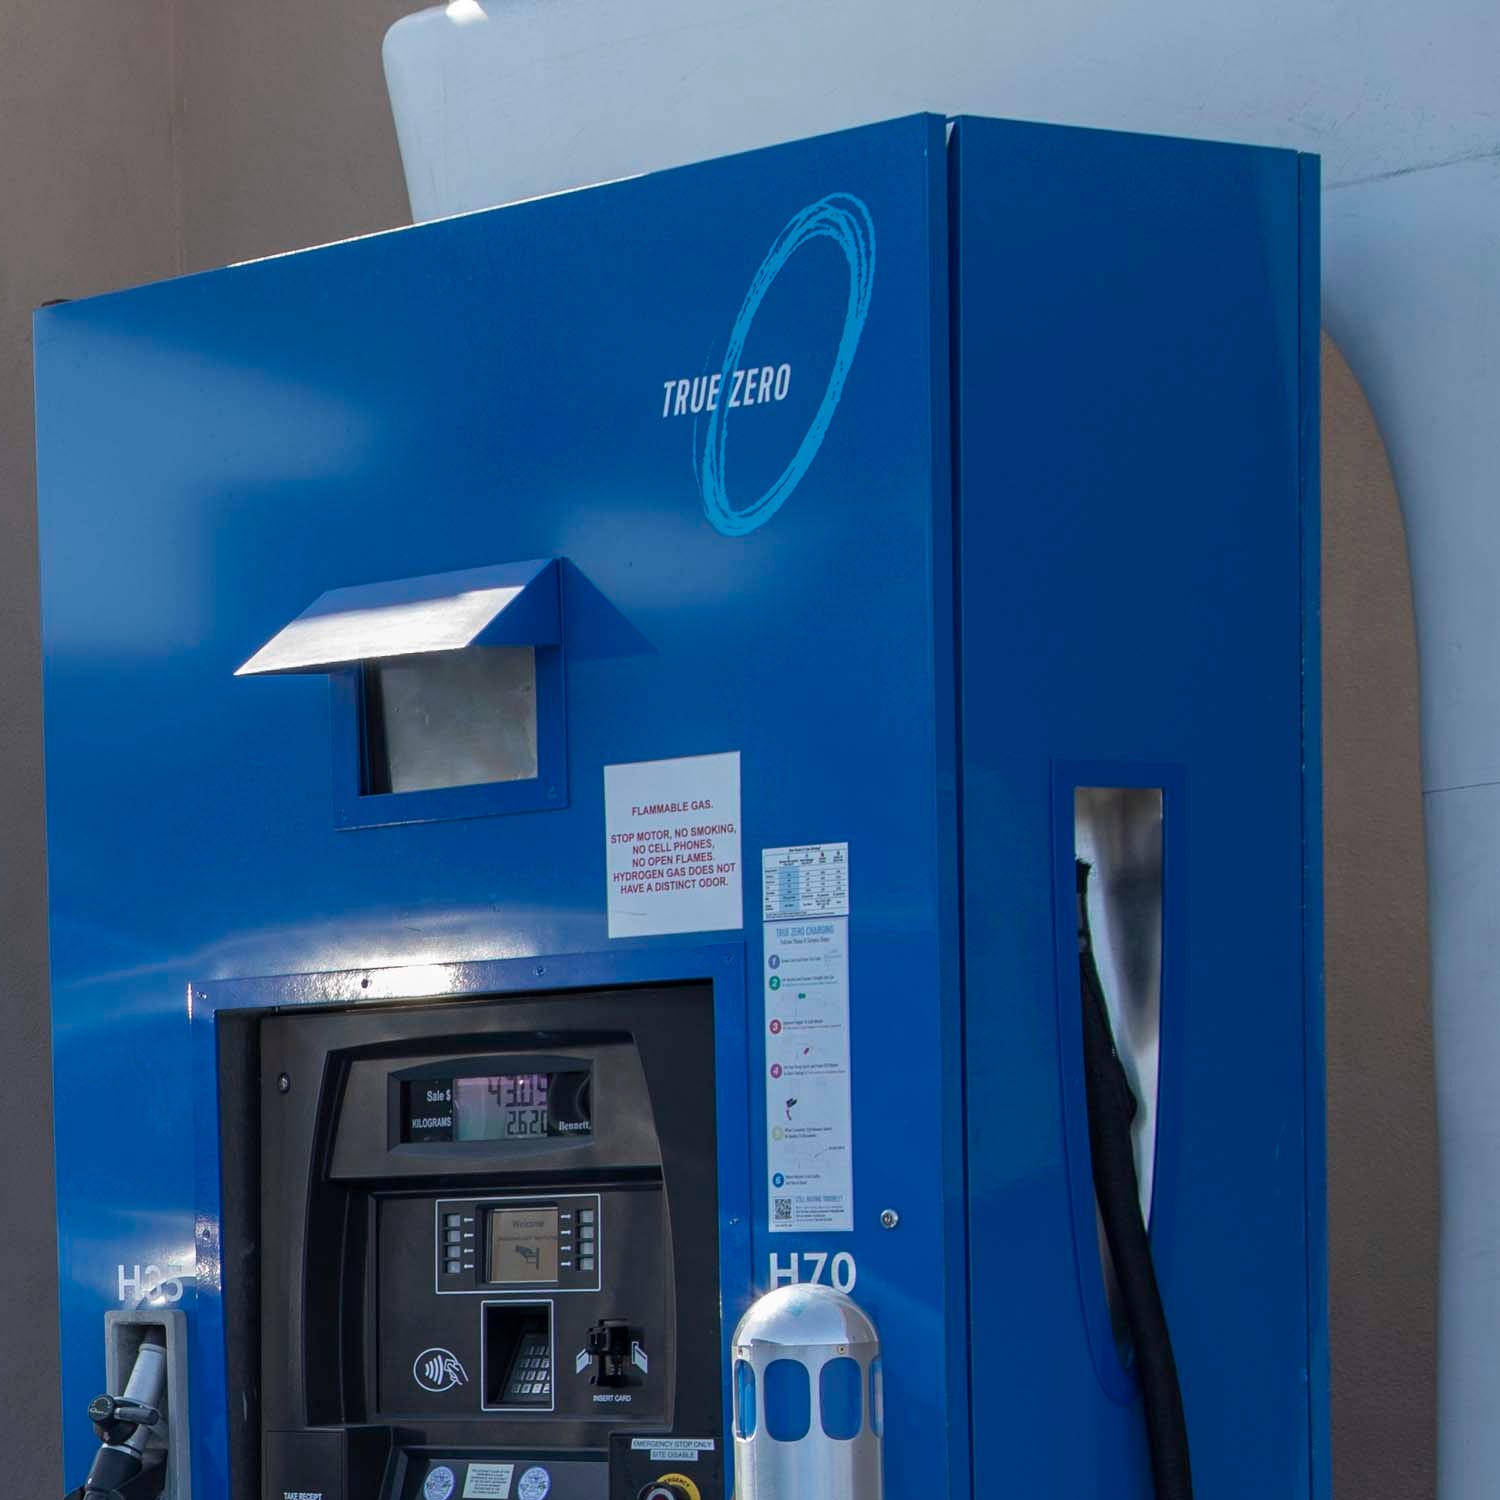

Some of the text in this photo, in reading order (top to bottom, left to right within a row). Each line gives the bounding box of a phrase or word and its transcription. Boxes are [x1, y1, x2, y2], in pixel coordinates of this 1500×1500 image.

[662, 363, 791, 418] TRUE ZERO
[632, 800, 713, 816] FLAMMABLE GAS.
[611, 824, 736, 844] STOP MOTOR, NO SMOKING,
[633, 839, 714, 855] NO CELL PHONES,
[632, 858, 645, 868] NO
[648, 856, 673, 866] OPEN
[613, 863, 736, 882] HYDROGEN GAS DOES NOT
[621, 877, 728, 894] HAVE A DISTINCT ODOR.
[426, 1089, 451, 1102] Sale $
[412, 1117, 451, 1129] KILOGRAMS
[769, 1252, 856, 1294] H70
[117, 1264, 183, 1302] H35
[615, 1394, 632, 1402] CARD
[633, 1440, 673, 1448] EMERGENCY
[284, 1492, 298, 1500] TAKE
